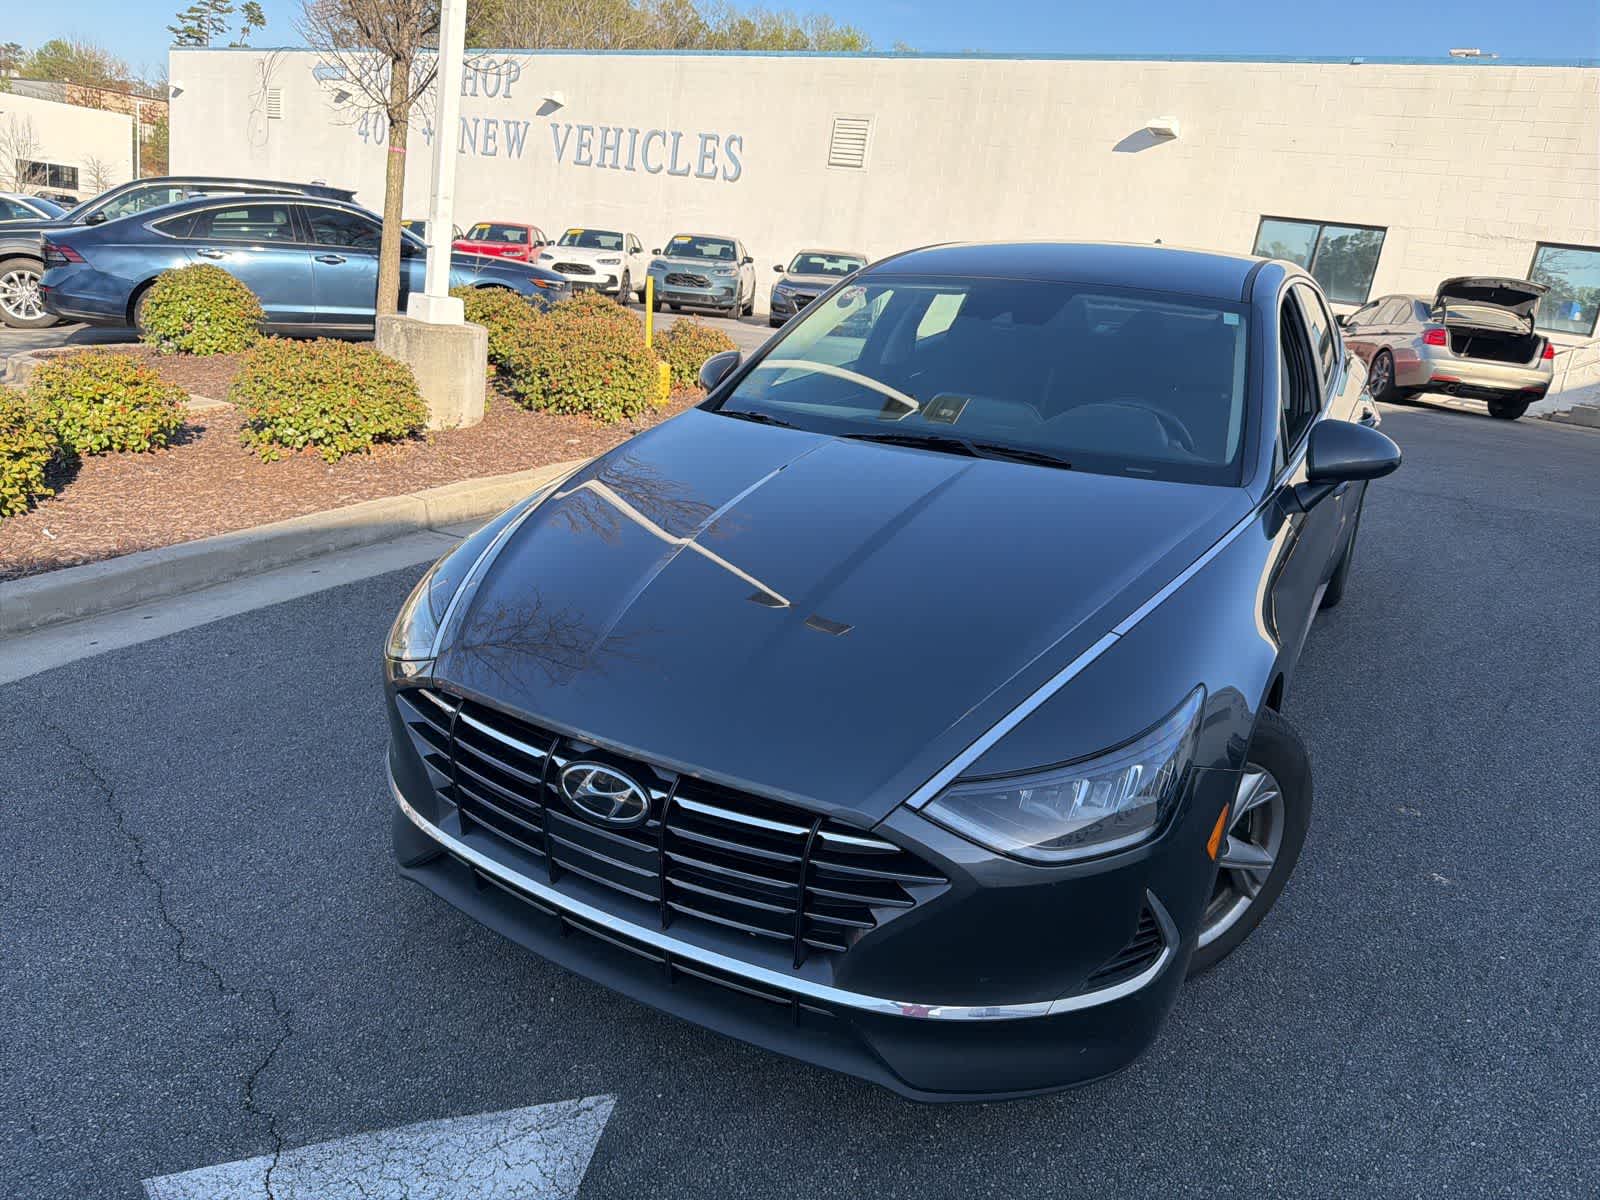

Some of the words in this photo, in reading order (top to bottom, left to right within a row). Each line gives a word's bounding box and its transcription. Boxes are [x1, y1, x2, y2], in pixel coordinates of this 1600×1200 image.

[461, 58, 521, 99] HOP
[457, 116, 531, 160] NEW
[550, 122, 744, 183] VEHICLES
